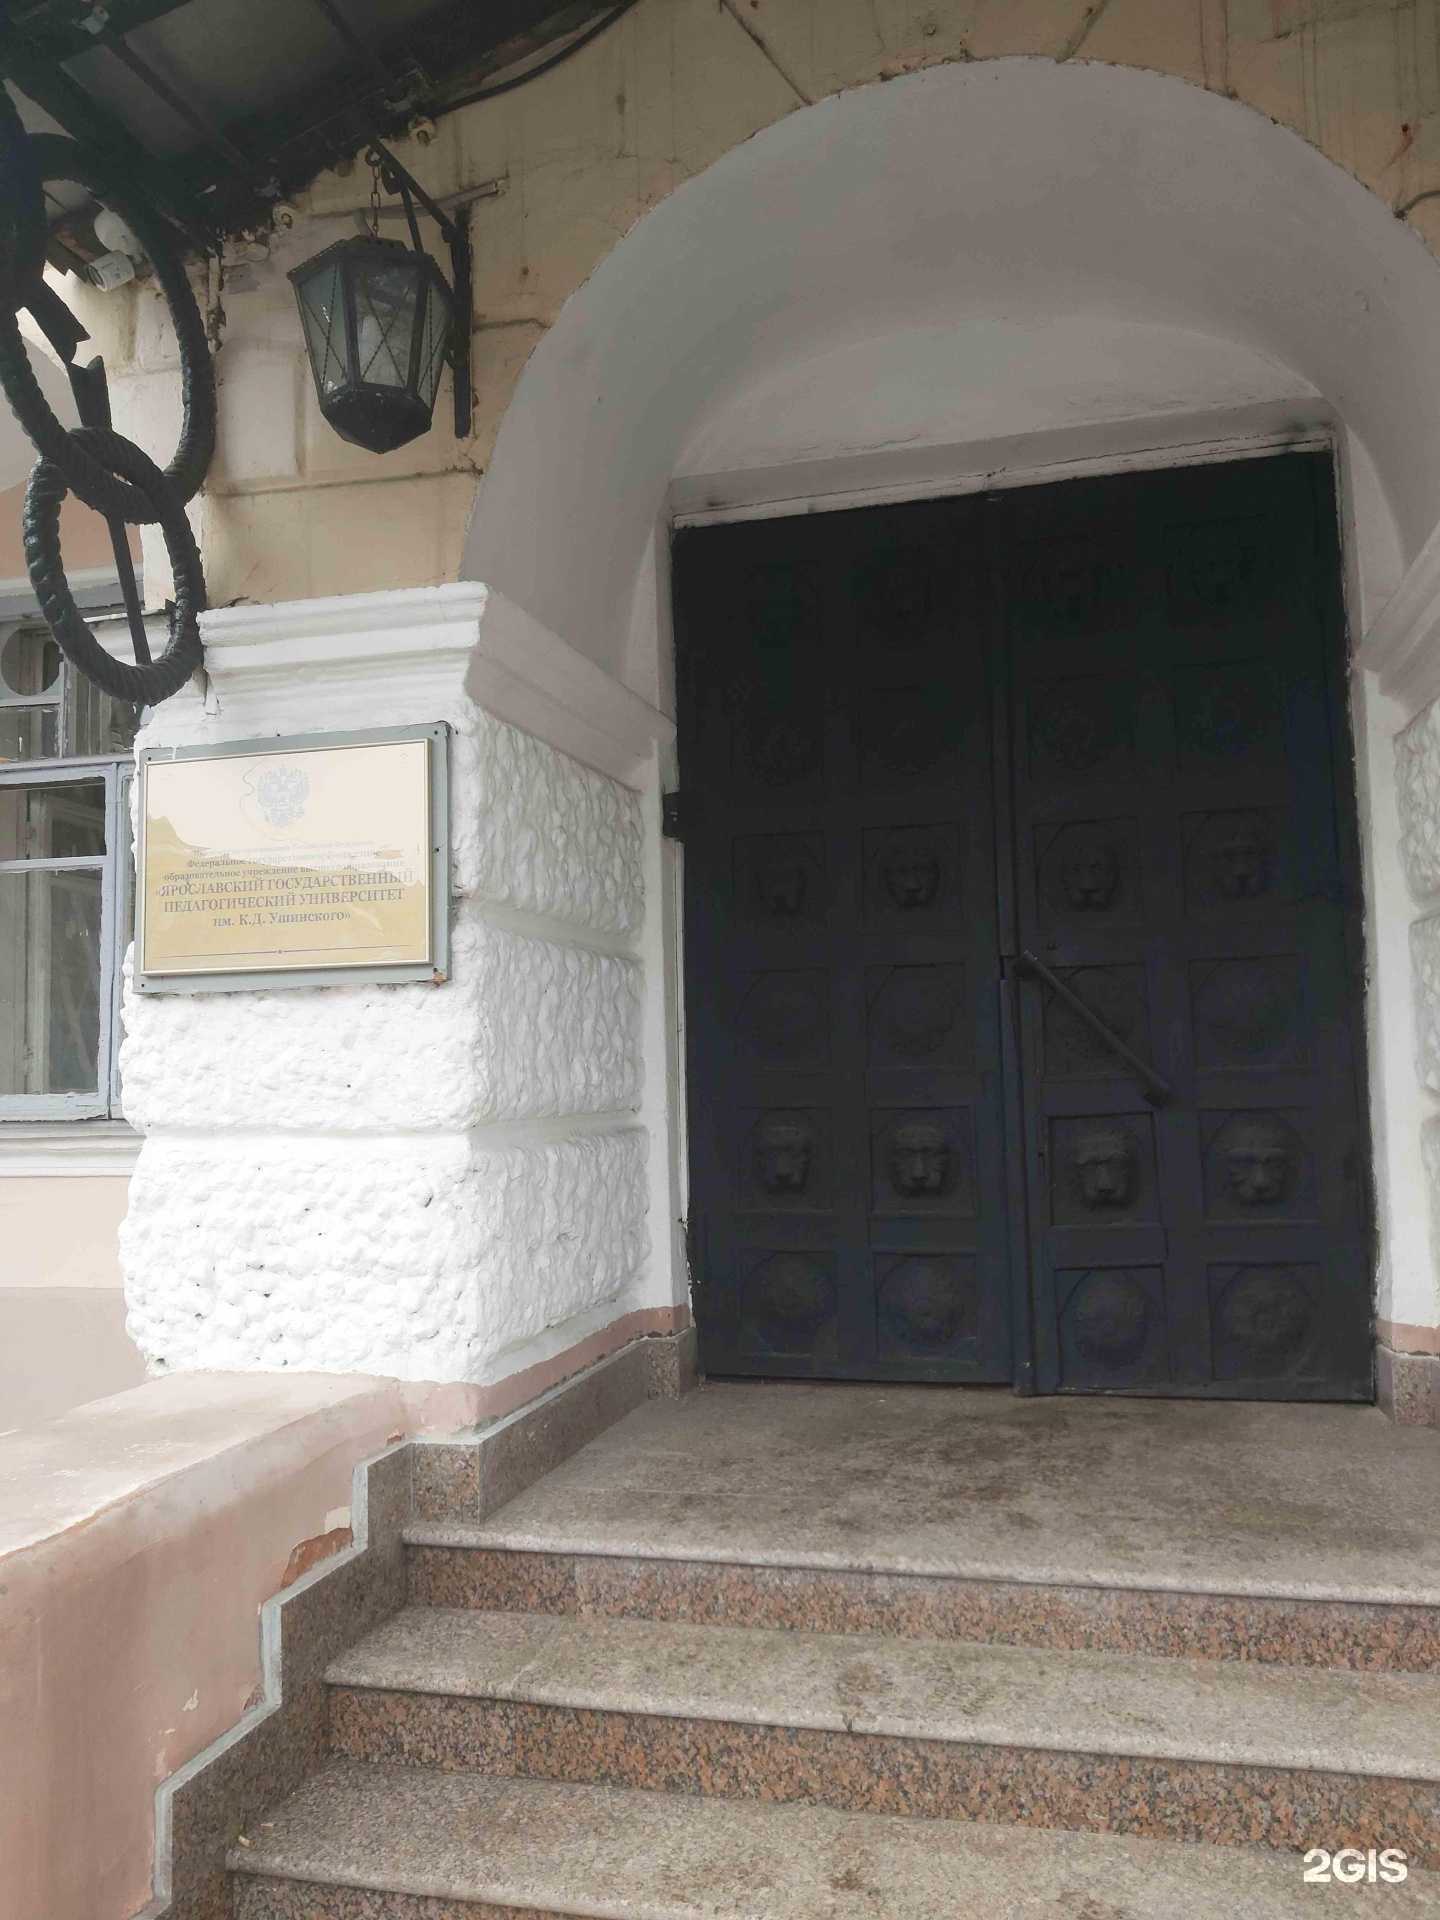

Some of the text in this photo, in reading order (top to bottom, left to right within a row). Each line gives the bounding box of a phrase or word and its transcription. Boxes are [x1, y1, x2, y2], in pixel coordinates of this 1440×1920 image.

[164, 888, 405, 912] ПЕДАГОГИЧЕСКИЙ УНИВЕРСИТЕТ
[213, 917, 234, 927] им.
[269, 911, 351, 924] Ушинского»
